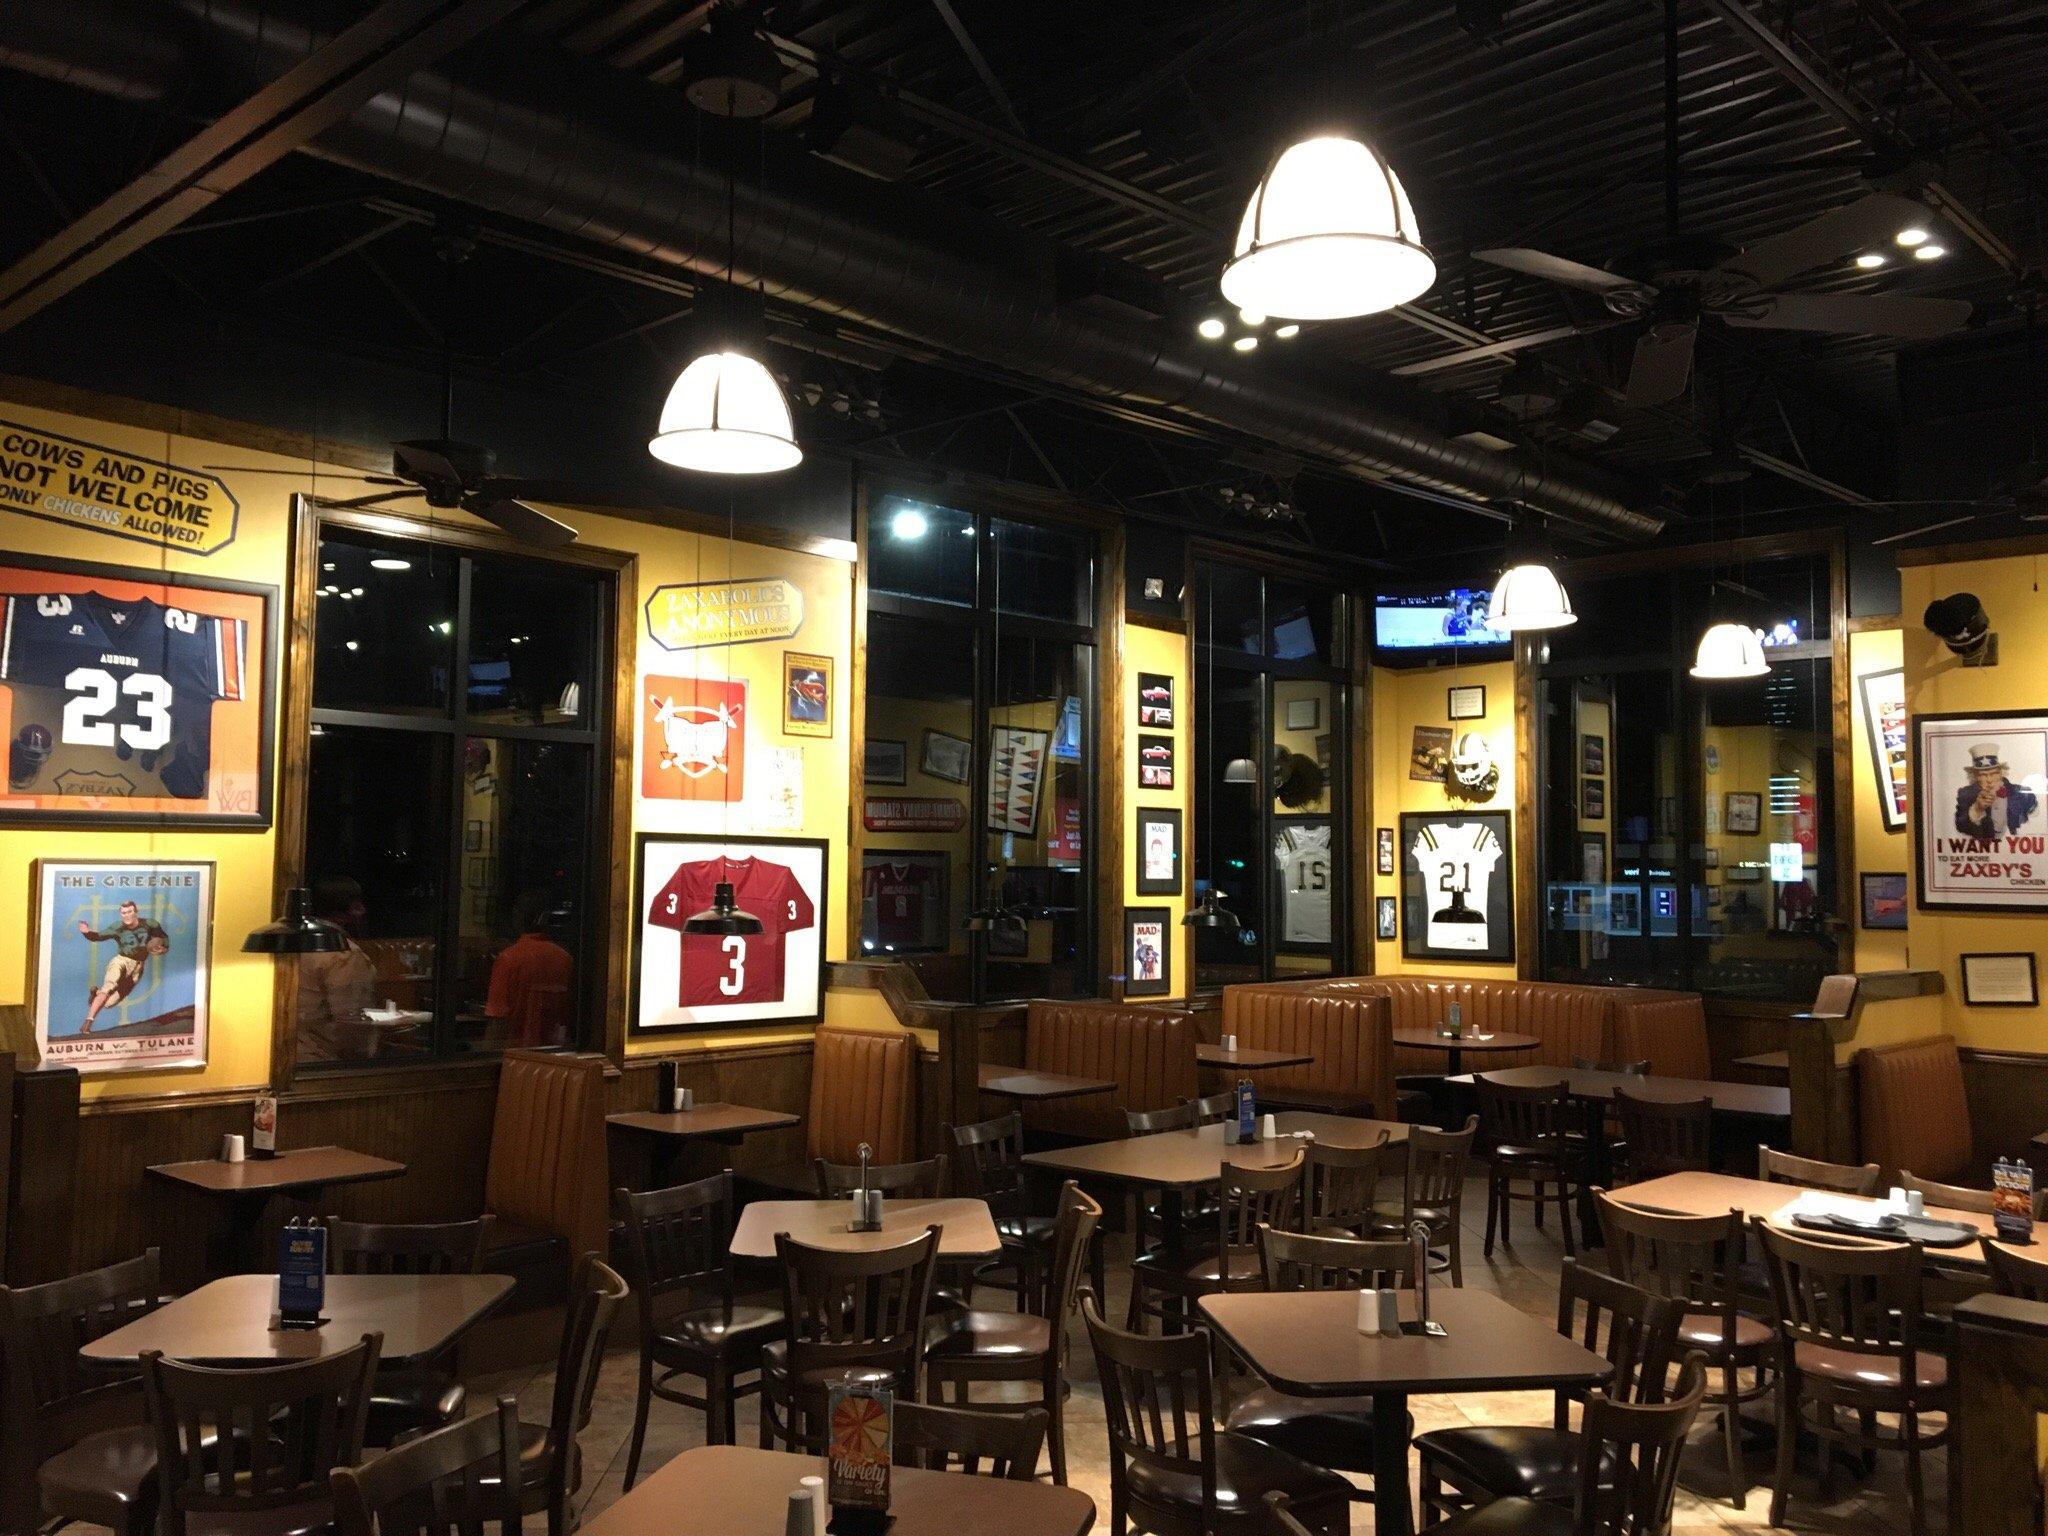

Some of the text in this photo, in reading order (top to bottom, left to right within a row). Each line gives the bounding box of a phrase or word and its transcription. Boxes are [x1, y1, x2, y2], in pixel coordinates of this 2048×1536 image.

[3, 434, 209, 501] COWS AND PIGS
[0, 455, 212, 528] NOT WELCOME
[0, 484, 204, 544] ONLY CHICKENS ALLOWED!
[100, 653, 139, 667] AUBURN
[62, 667, 173, 750] 23
[1151, 825, 1167, 833] MAD
[1937, 836, 2045, 855] I WANT YOU
[1950, 855, 1965, 863] EAT
[1967, 855, 1990, 863] MORE
[1439, 861, 1472, 893] 21
[1950, 862, 2032, 879] ZAXBY'S
[60, 875, 194, 888] THE GREENIE
[2009, 878, 2046, 886] CHICKEN
[666, 893, 678, 915] 3
[787, 900, 797, 921] 3
[1136, 926, 1157, 936] MAD
[719, 935, 746, 996] 3
[46, 1042, 104, 1055] AUBURN
[137, 1037, 194, 1049] TULANE
[834, 1459, 886, 1488] Variety
